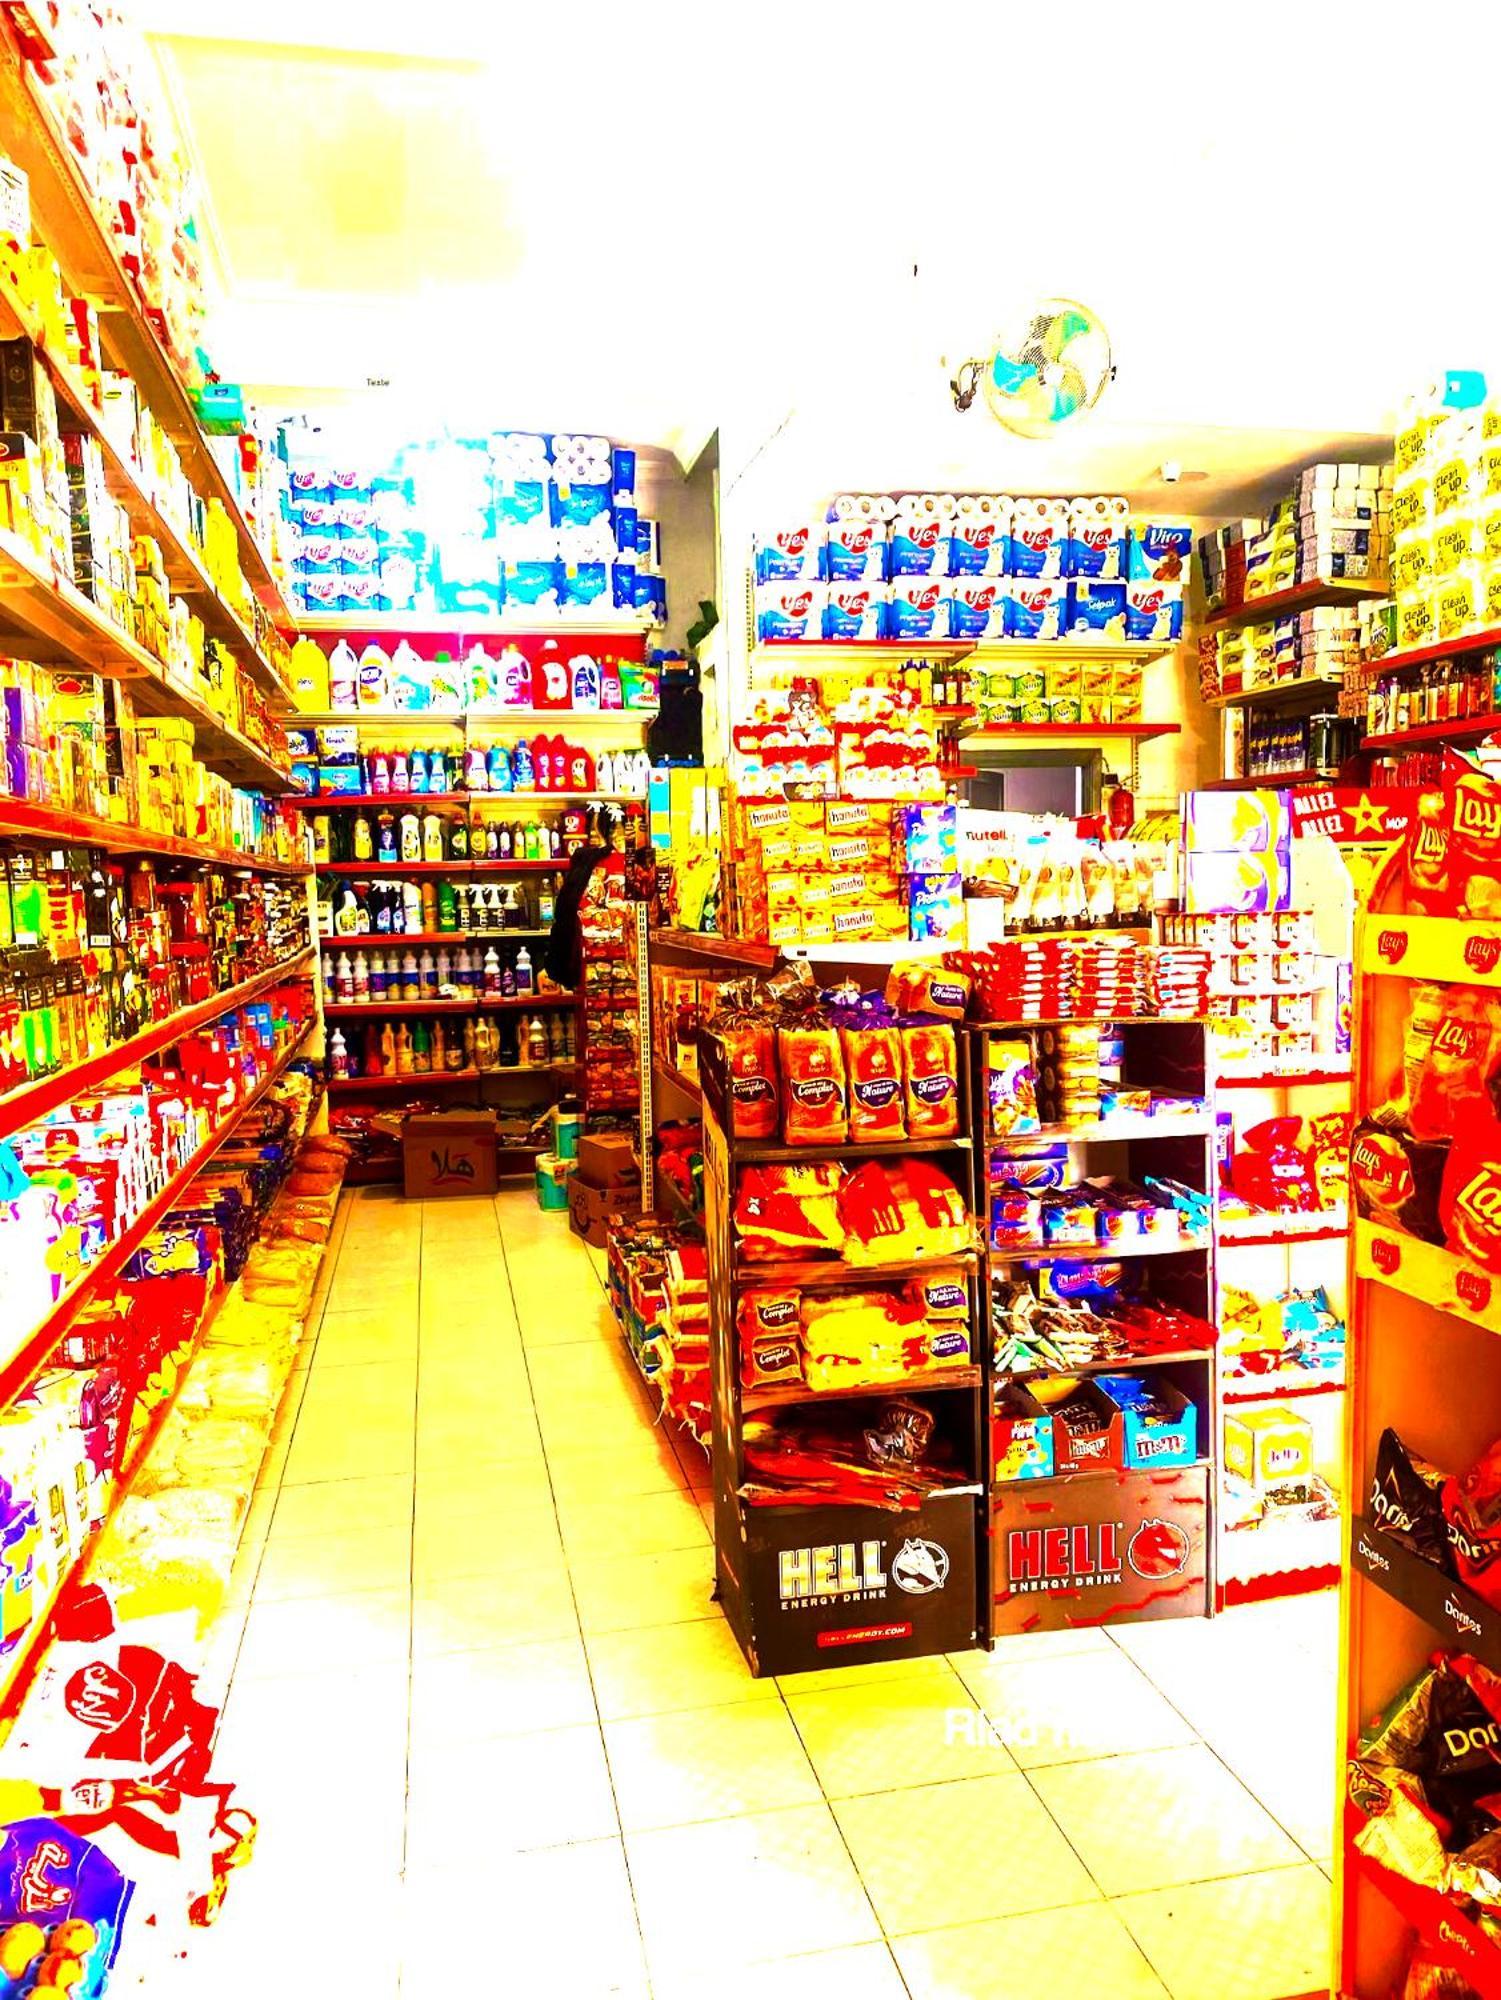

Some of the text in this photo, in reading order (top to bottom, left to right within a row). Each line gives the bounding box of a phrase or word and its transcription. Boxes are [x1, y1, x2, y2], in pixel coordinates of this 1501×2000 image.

[1404, 606, 1426, 622] Clean
[1416, 613, 1430, 628] up
[798, 1083, 833, 1101] Complet
[862, 1084, 894, 1099] Nature
[918, 1082, 950, 1096] Nature
[763, 1304, 794, 1320] Complet
[1009, 1523, 1123, 1581] HELL
[779, 1540, 888, 1599] HELL
[1009, 1573, 1122, 1594] ENERGY DRINK
[781, 1588, 888, 1611] ENERGY DRINK
[1445, 1599, 1483, 1637] Doritos
